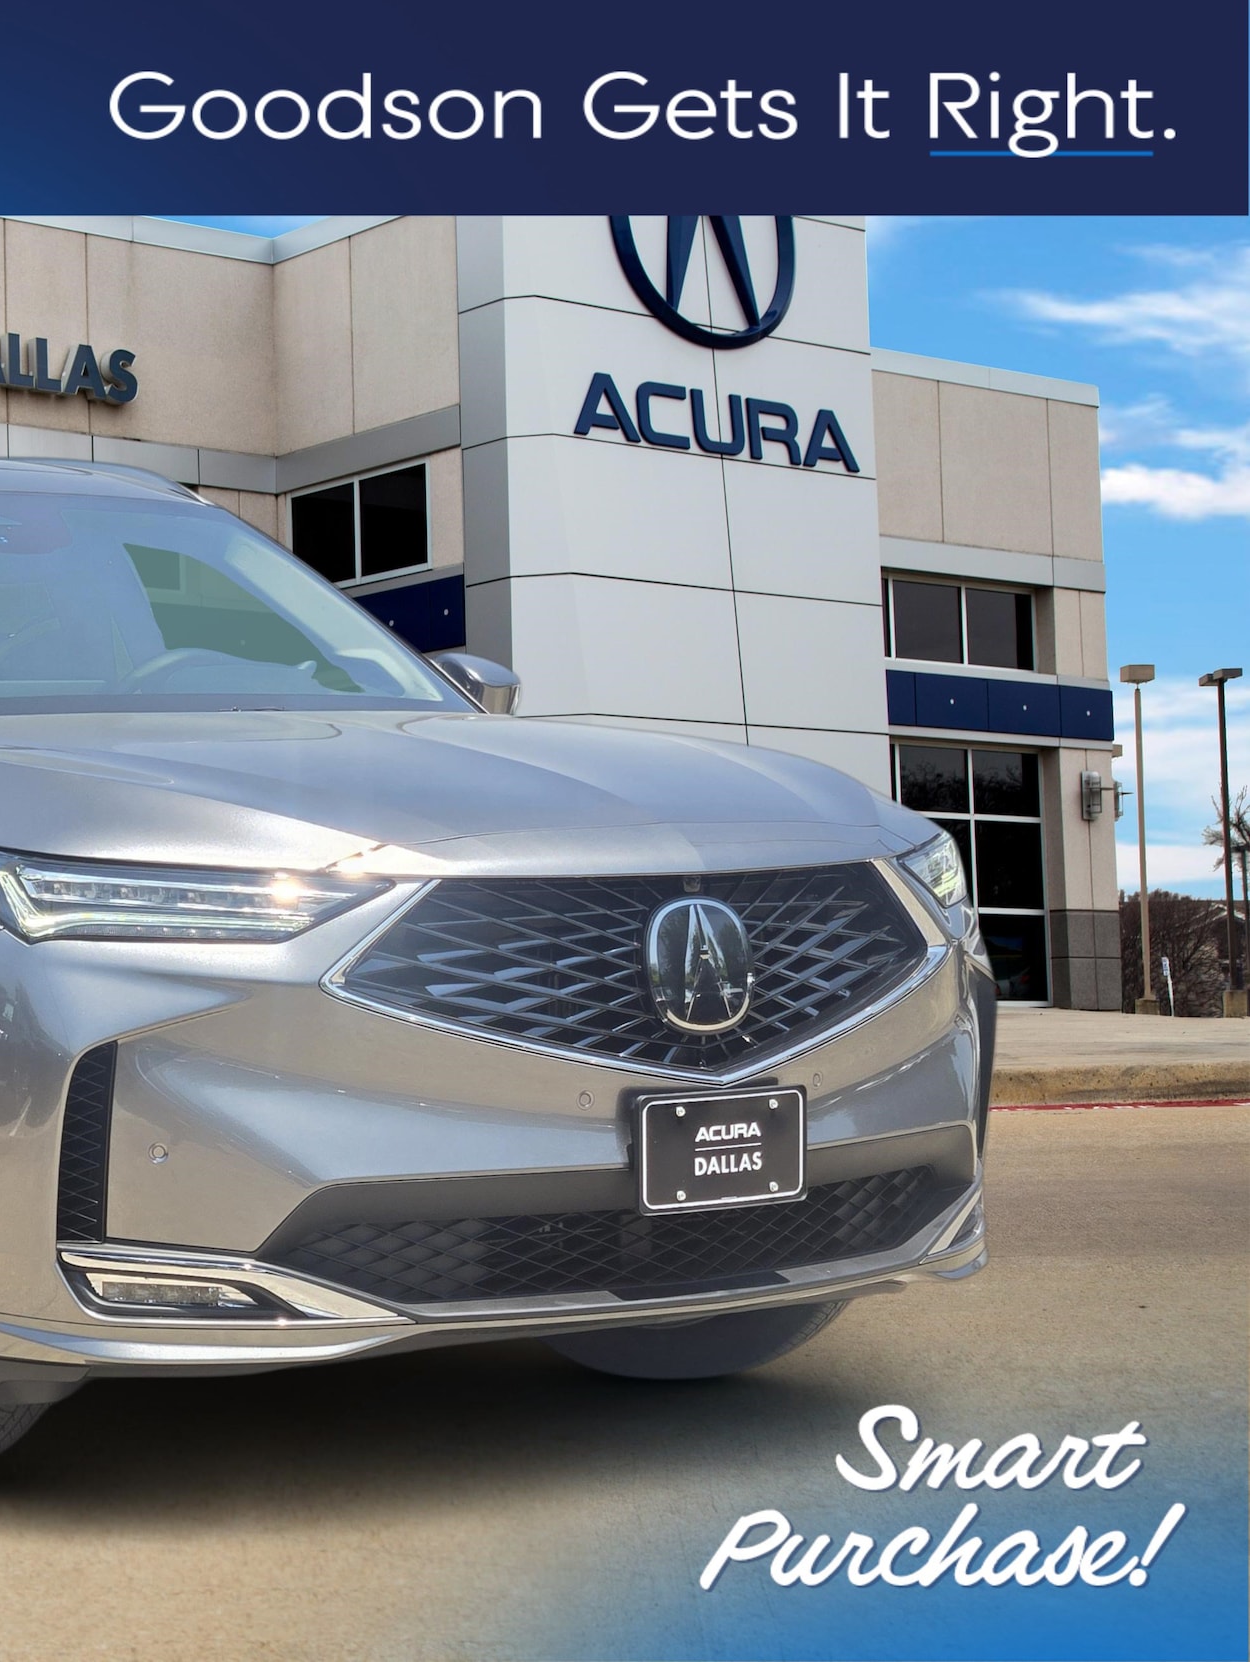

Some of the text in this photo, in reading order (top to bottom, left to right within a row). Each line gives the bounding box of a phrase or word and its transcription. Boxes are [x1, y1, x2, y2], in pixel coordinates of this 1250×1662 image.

[574, 371, 860, 473] ACURA
[694, 1121, 762, 1143] ACURA
[694, 1151, 763, 1177] DALLAS
